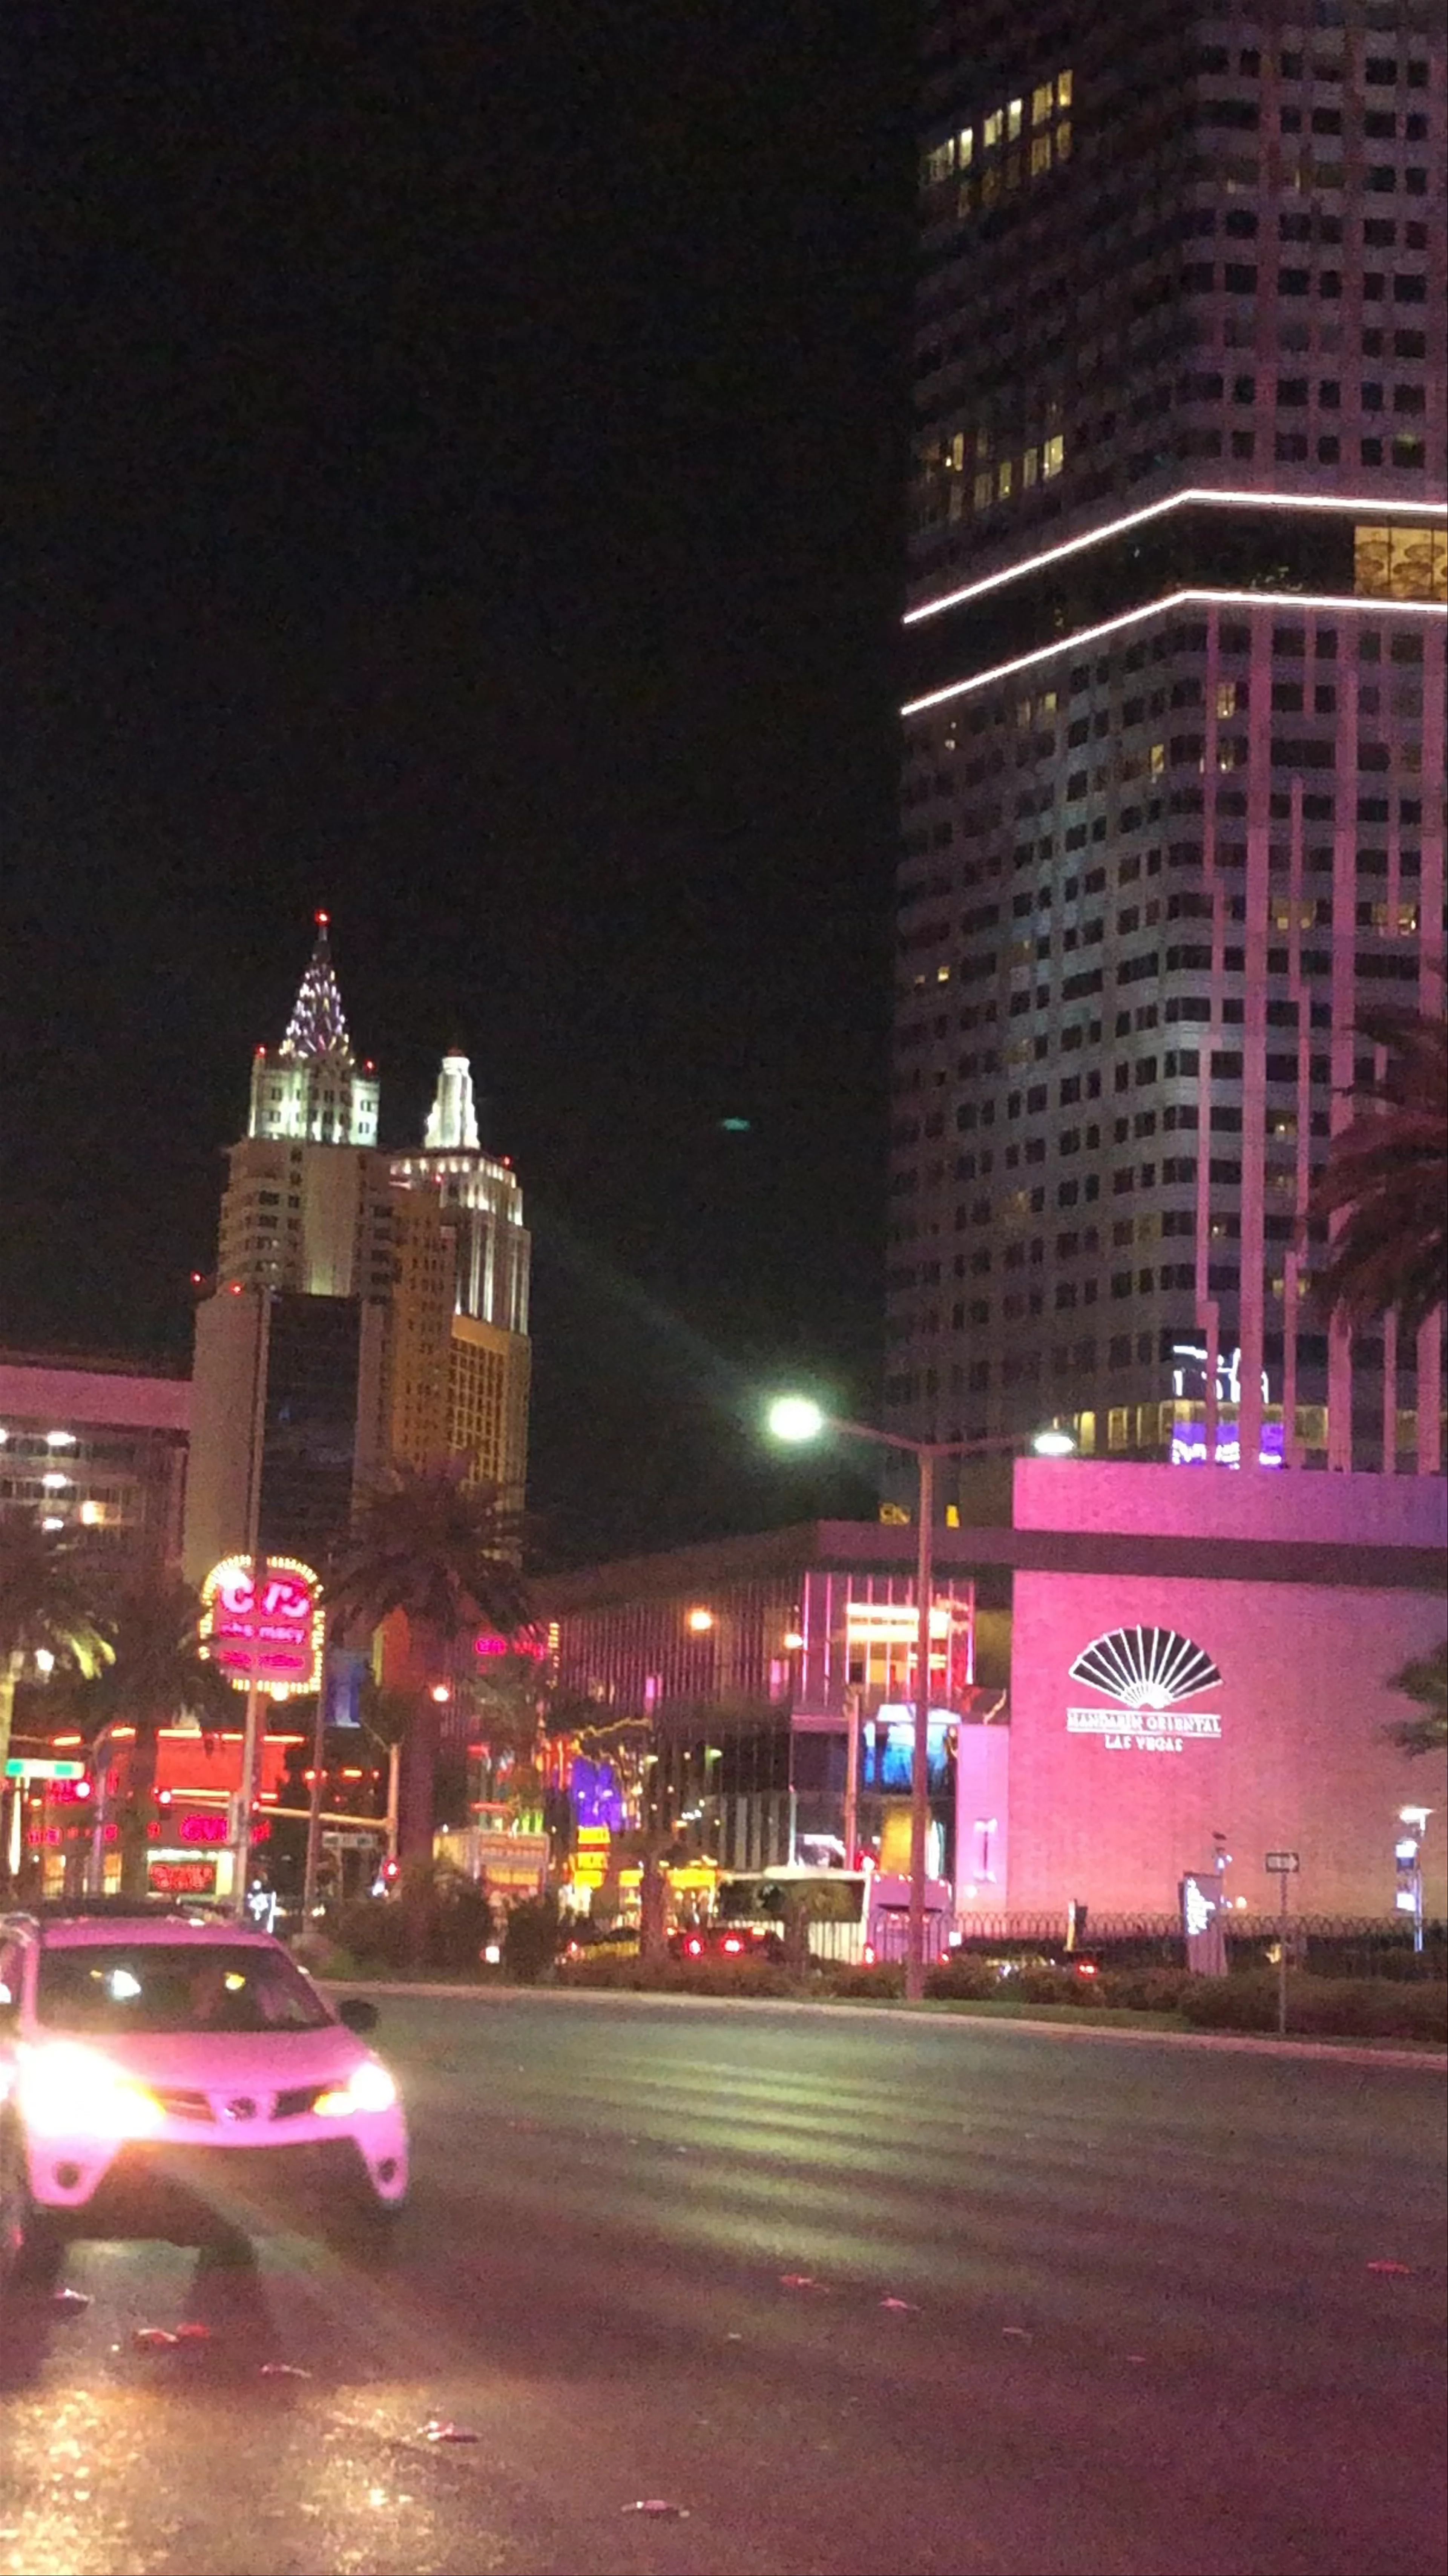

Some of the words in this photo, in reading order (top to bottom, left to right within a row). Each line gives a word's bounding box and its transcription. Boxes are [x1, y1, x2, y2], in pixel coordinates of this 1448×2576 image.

[1068, 1712, 1144, 1731] MANDARIN
[1146, 1716, 1221, 1733] ORIENTAL
[1104, 1734, 1132, 1750] LAS
[1136, 1735, 1183, 1752] VEGAS
